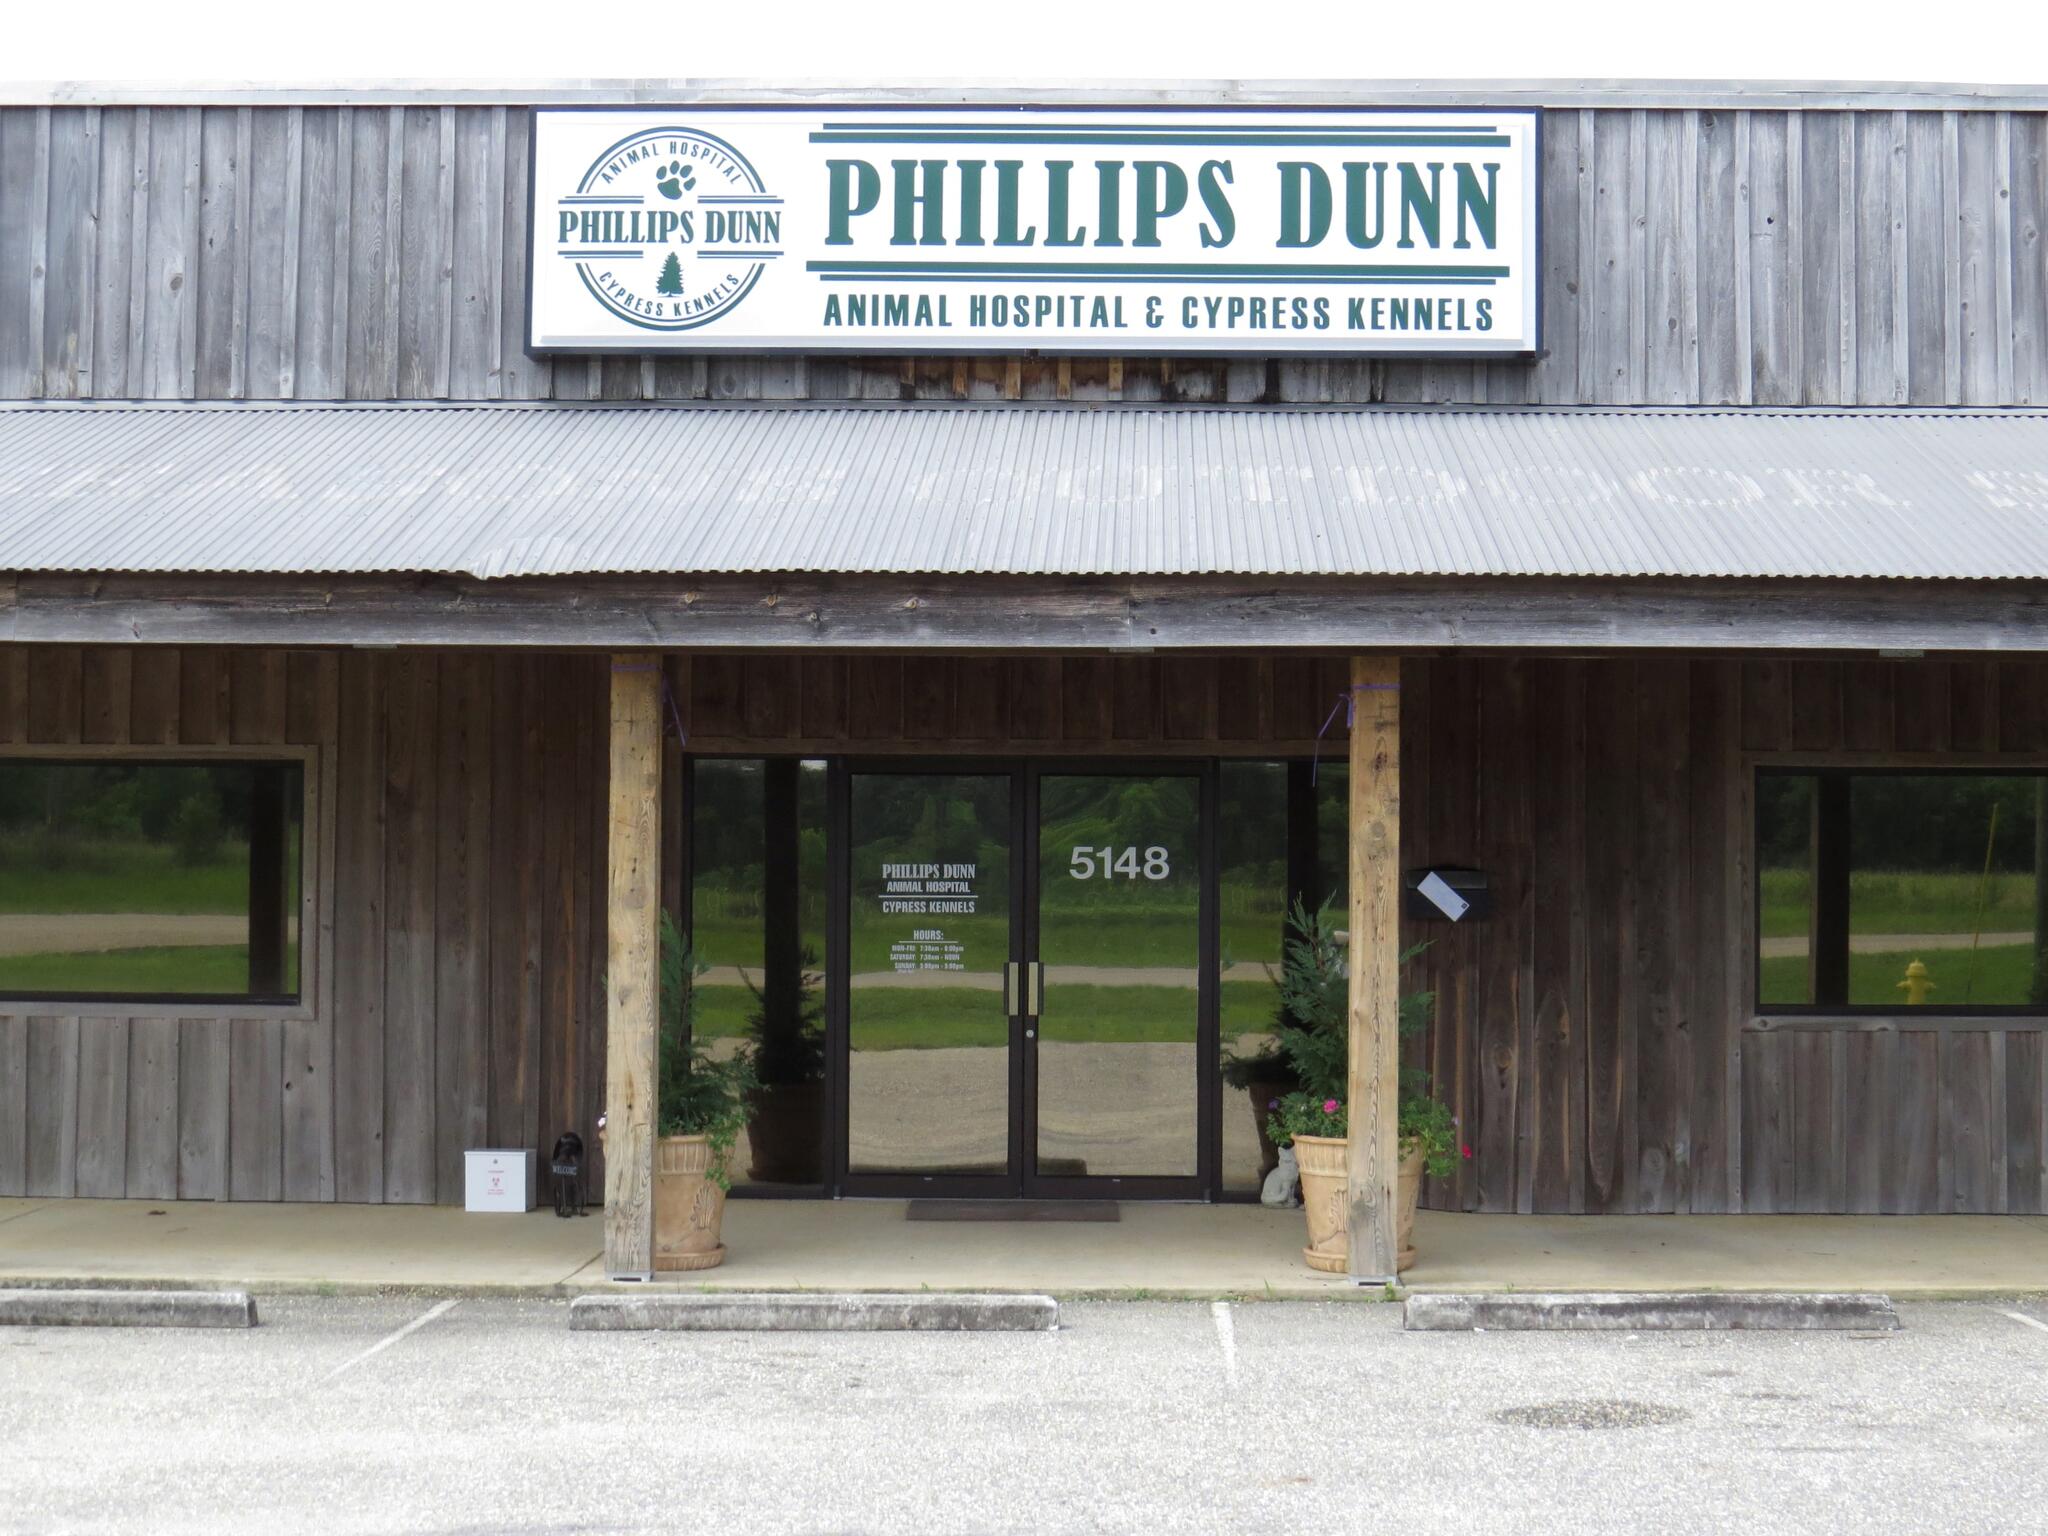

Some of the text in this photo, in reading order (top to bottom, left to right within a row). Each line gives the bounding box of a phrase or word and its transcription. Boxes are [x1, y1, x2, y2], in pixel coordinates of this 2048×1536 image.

[600, 140, 742, 186] ANIMAL HOSPITAL
[825, 160, 1500, 249] PHILLIPS DUNN
[559, 211, 780, 243] PHILLIPS DUNN
[599, 270, 740, 318] CYPRESS KENNELS
[824, 294, 1492, 331] ANIMAL HOSPITAL & CYPRESS KENNELS
[882, 864, 976, 879] PHILLIPS DUNN
[1069, 846, 1170, 880] 5148
[887, 881, 971, 893] ANIMAL HOSPITAL
[882, 901, 975, 913] CYPRESS KENNELS
[913, 930, 944, 941] HOURS:
